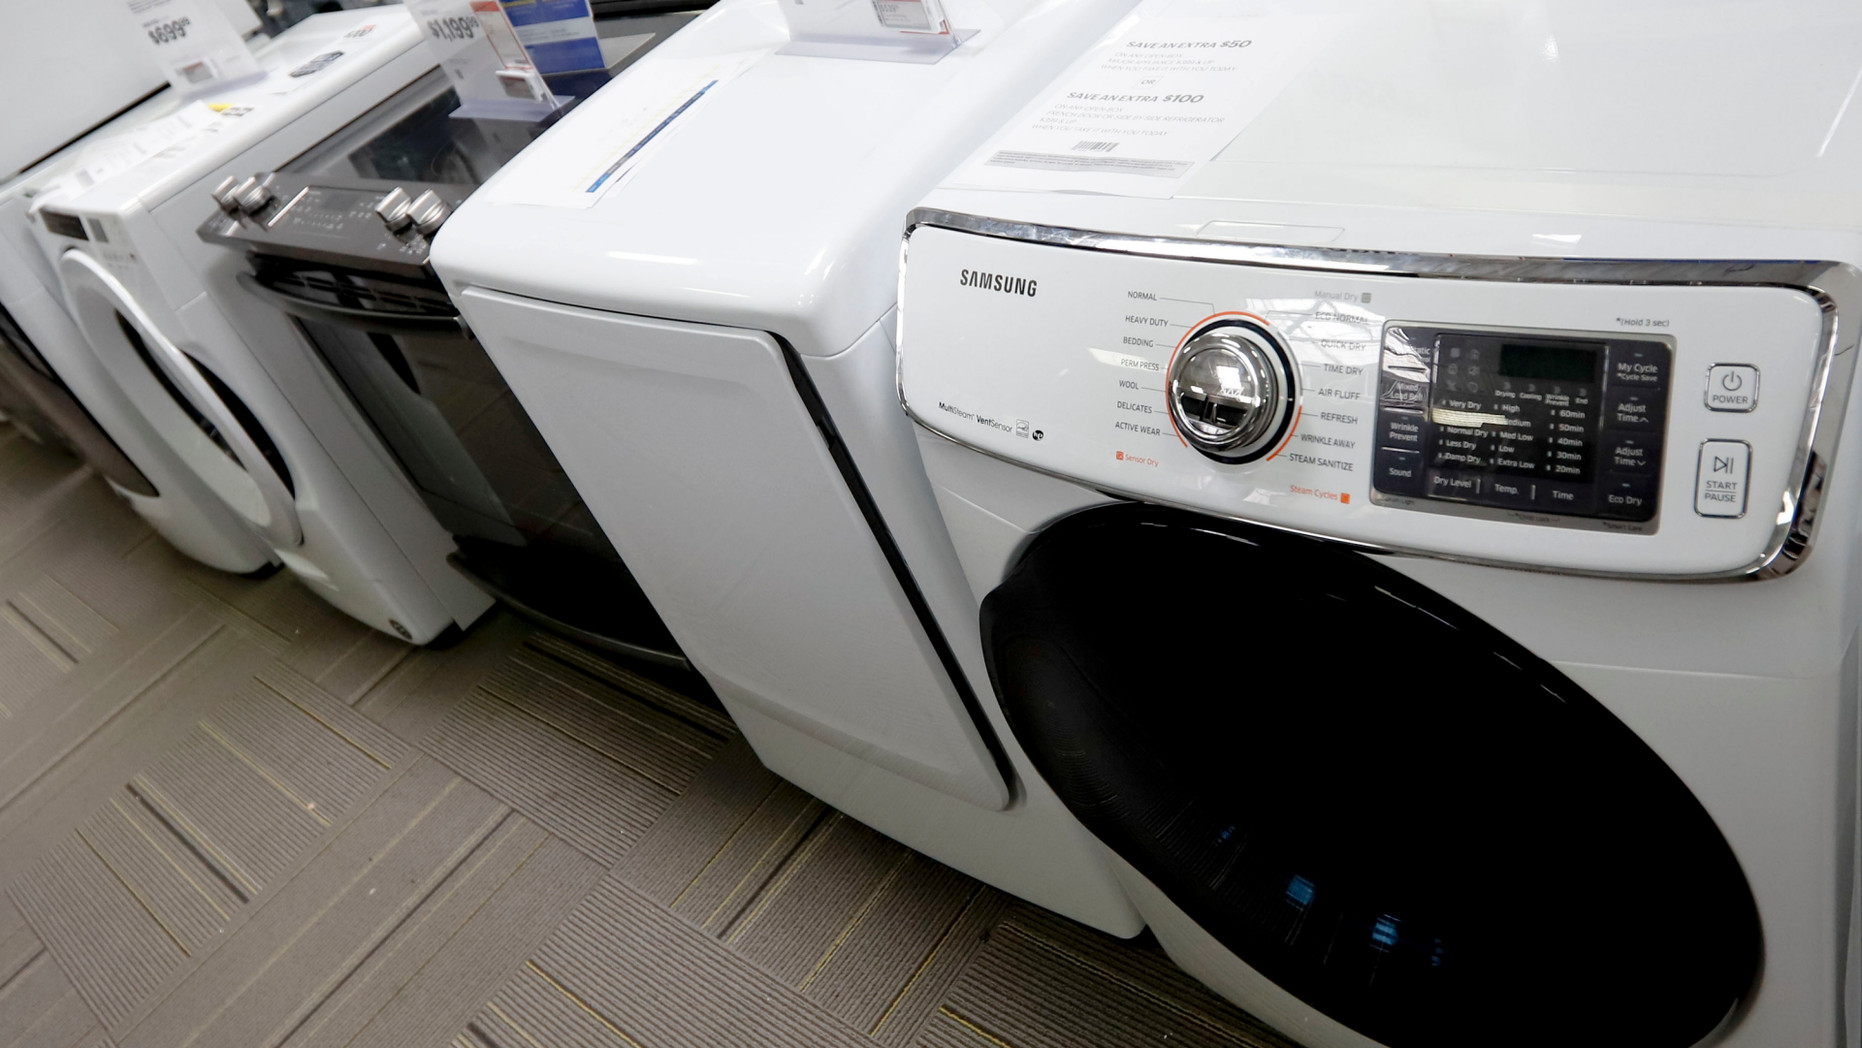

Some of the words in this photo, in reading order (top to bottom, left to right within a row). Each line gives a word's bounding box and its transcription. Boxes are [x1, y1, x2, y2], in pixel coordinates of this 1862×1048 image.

[1126, 40, 1155, 49] SAVE
[1175, 41, 1217, 49] EXTRA
[1219, 39, 1253, 49] $50
[1140, 78, 1157, 86] OR
[1066, 91, 1099, 101] SAVE
[1096, 94, 1122, 102] AN
[1118, 94, 1159, 103] EXTRA
[1162, 93, 1205, 104] $100
[1161, 115, 1226, 123] REFRIGERATOR
[960, 268, 1038, 298] SAMSUNG
[1127, 291, 1157, 301] NORMAL
[1314, 290, 1342, 300] Manual
[1344, 292, 1359, 302] Dry
[1125, 315, 1149, 325] HEAVY
[1149, 317, 1169, 327] DUTY
[1645, 318, 1651, 327] 3
[1652, 319, 1670, 328] sec)
[1123, 336, 1154, 348] BEDDING
[1320, 339, 1347, 349] QUICK
[1349, 342, 1367, 352] DRY
[1120, 358, 1139, 368] PERM
[1139, 361, 1160, 371] PRESS
[1323, 363, 1344, 374] TIME
[1345, 366, 1364, 375] DRY
[1618, 362, 1632, 373] My
[1634, 363, 1659, 374] Cycle
[1640, 374, 1658, 382] Save
[1119, 380, 1139, 390] WOOL
[1396, 382, 1419, 391] Mixed
[1318, 387, 1333, 397] AIR
[1334, 389, 1361, 401] FLUFF
[1495, 390, 1516, 399] Drying
[1519, 392, 1543, 401] Cooling
[1546, 393, 1570, 402] Wrinkle
[1712, 394, 1749, 404] POWER
[1449, 400, 1467, 410] Very
[1467, 401, 1482, 411] Dry
[1545, 399, 1569, 407] Prevent
[1575, 397, 1588, 405] End
[1116, 401, 1153, 414] DELICATES
[1502, 403, 1521, 413] High
[1618, 403, 1646, 414] Adjust
[1320, 411, 1358, 424] REFRESH
[1559, 409, 1586, 419] 60min
[1616, 413, 1638, 422] Time
[976, 414, 1013, 433] VentSensor
[1115, 421, 1139, 432] ACTIVE
[1140, 425, 1161, 436] WEAR
[1390, 421, 1419, 433] Wrinkle
[1558, 423, 1584, 433] 50min
[1389, 432, 1418, 442] Prevent
[1447, 426, 1474, 437] Normal
[1474, 428, 1489, 439] Dry
[1500, 431, 1517, 441] Med
[1518, 432, 1534, 442] Low
[1446, 439, 1463, 448] Less
[1463, 441, 1477, 451] Dry
[1557, 437, 1583, 447] 40min
[1499, 444, 1515, 454] Low
[1615, 446, 1644, 458] Adjust
[1125, 454, 1147, 464] Sensor
[1147, 458, 1159, 468] Dry
[1445, 452, 1466, 463] Damp
[1467, 454, 1482, 464] Dry
[1556, 450, 1582, 461] 30min
[1614, 456, 1636, 466] Time
[1289, 453, 1316, 465] STEAM
[1317, 457, 1354, 472] SANITIZE
[1498, 457, 1518, 468] Extra
[1518, 460, 1535, 469] Low
[1389, 467, 1412, 478] Sound
[1555, 464, 1581, 475] 20min
[1433, 475, 1449, 486] Dry
[1450, 477, 1472, 489] Level
[1706, 480, 1738, 490] START
[1290, 484, 1313, 495] Steam
[1313, 489, 1338, 500] Cycles
[1494, 483, 1519, 495] Temp.
[1552, 490, 1574, 501] Time
[1608, 494, 1624, 504] Eco
[1625, 495, 1642, 506] Dry
[1704, 492, 1736, 502] PAUSE
